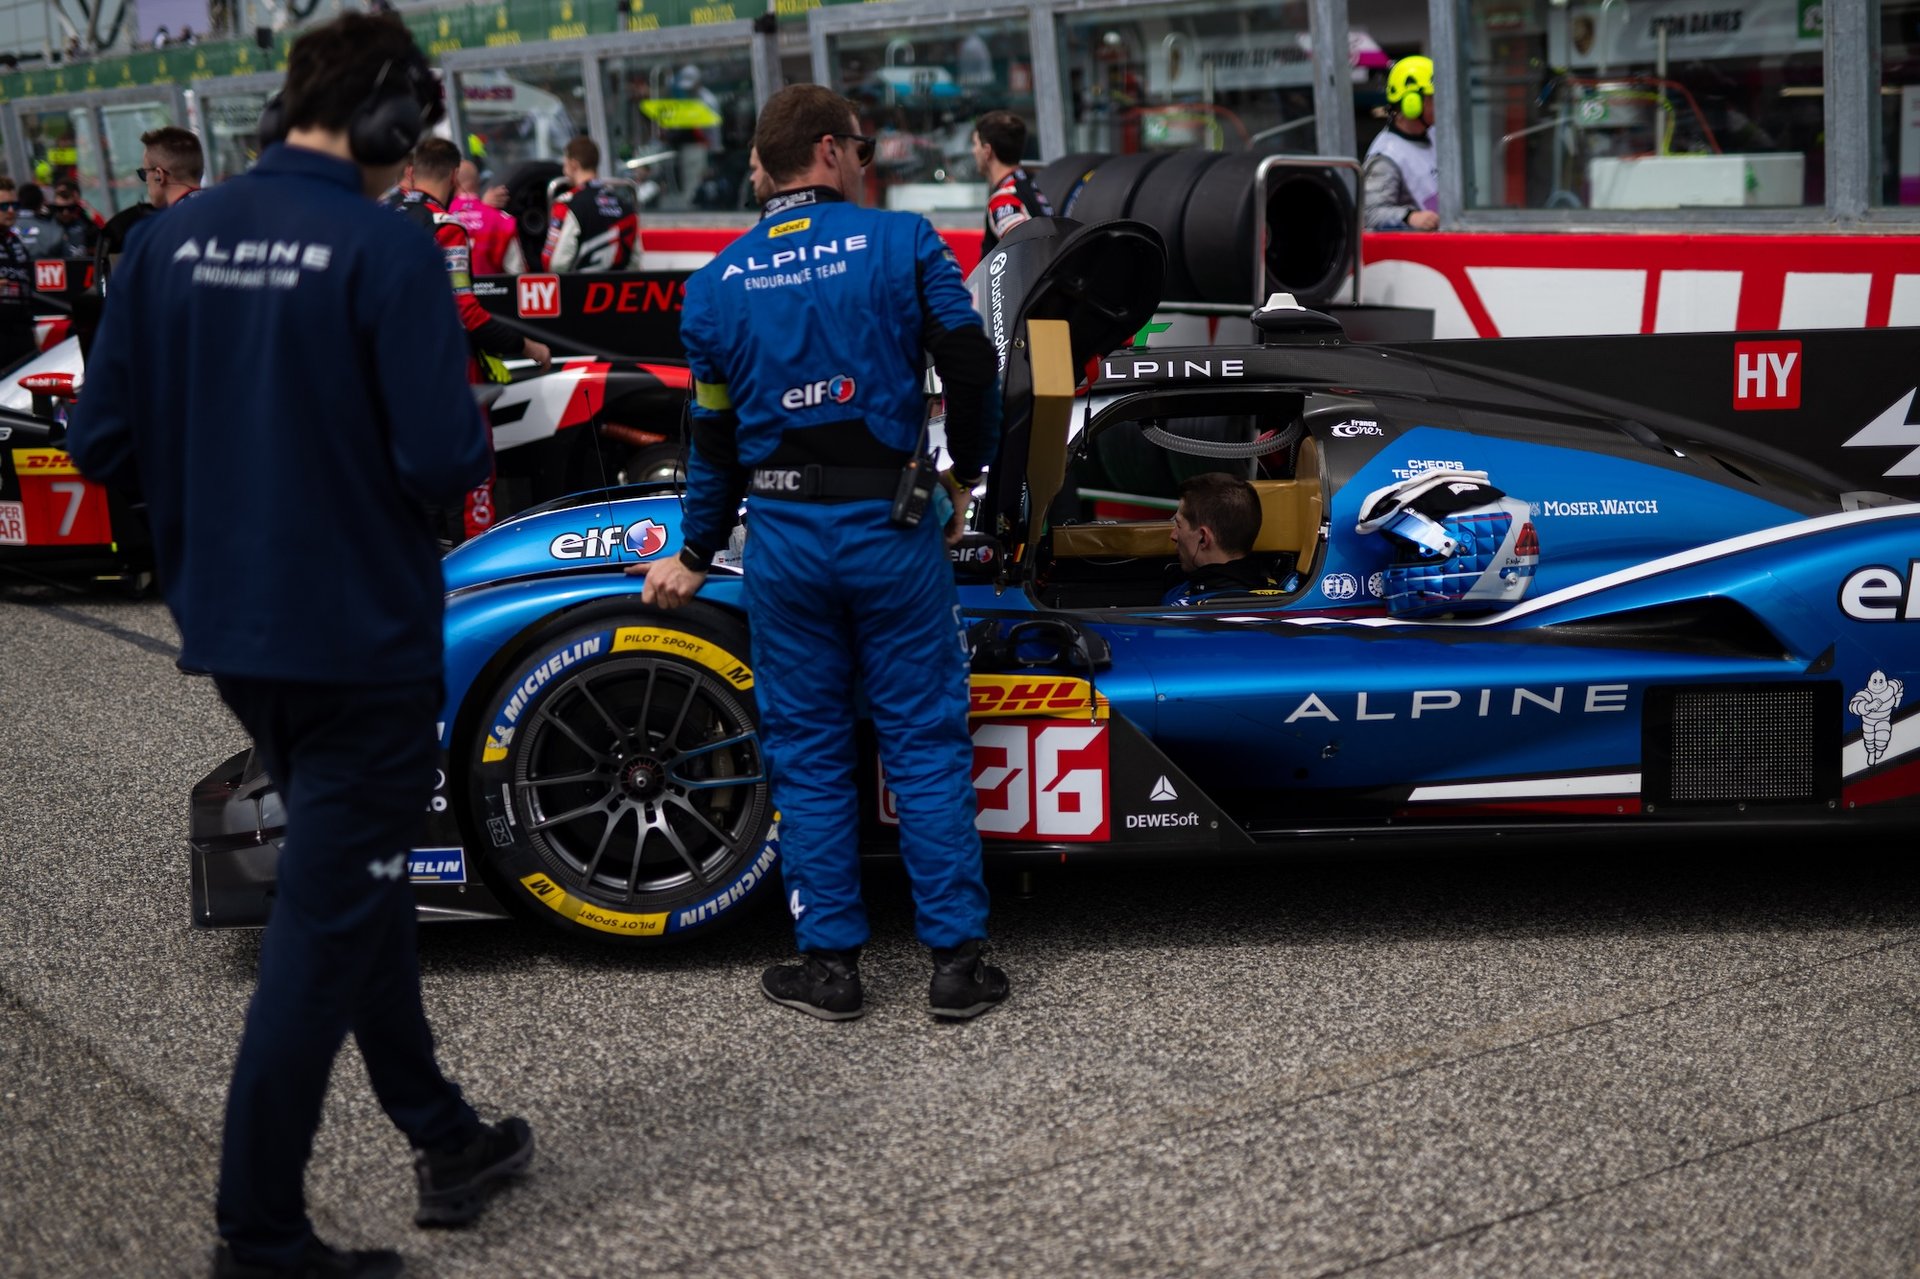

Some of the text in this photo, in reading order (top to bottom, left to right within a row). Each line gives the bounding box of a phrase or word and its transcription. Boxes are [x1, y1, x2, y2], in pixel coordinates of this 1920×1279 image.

[172, 236, 333, 272] ALPINE
[722, 234, 869, 281] ALPINE
[36, 265, 64, 286] HY
[816, 260, 847, 280] TEAM
[521, 281, 556, 312] HY
[1105, 360, 1245, 379] LPINE
[1737, 352, 1799, 399] HY
[782, 380, 828, 410] elf
[1350, 419, 1378, 428] France
[26, 454, 78, 469] DH
[1407, 459, 1466, 471] CHEOPS
[50, 481, 86, 538] 7
[551, 524, 622, 560] elf
[623, 633, 704, 654] PILOT SPORT
[503, 636, 602, 722] MICHELIN
[725, 665, 753, 687] M
[970, 682, 1087, 712] DHL
[1283, 684, 1630, 724] ALPINE
[1126, 812, 1199, 829] DEWESoft
[528, 878, 555, 897] M
[680, 844, 780, 928] MICHELIN
[577, 910, 656, 930] PILOT SPORT
